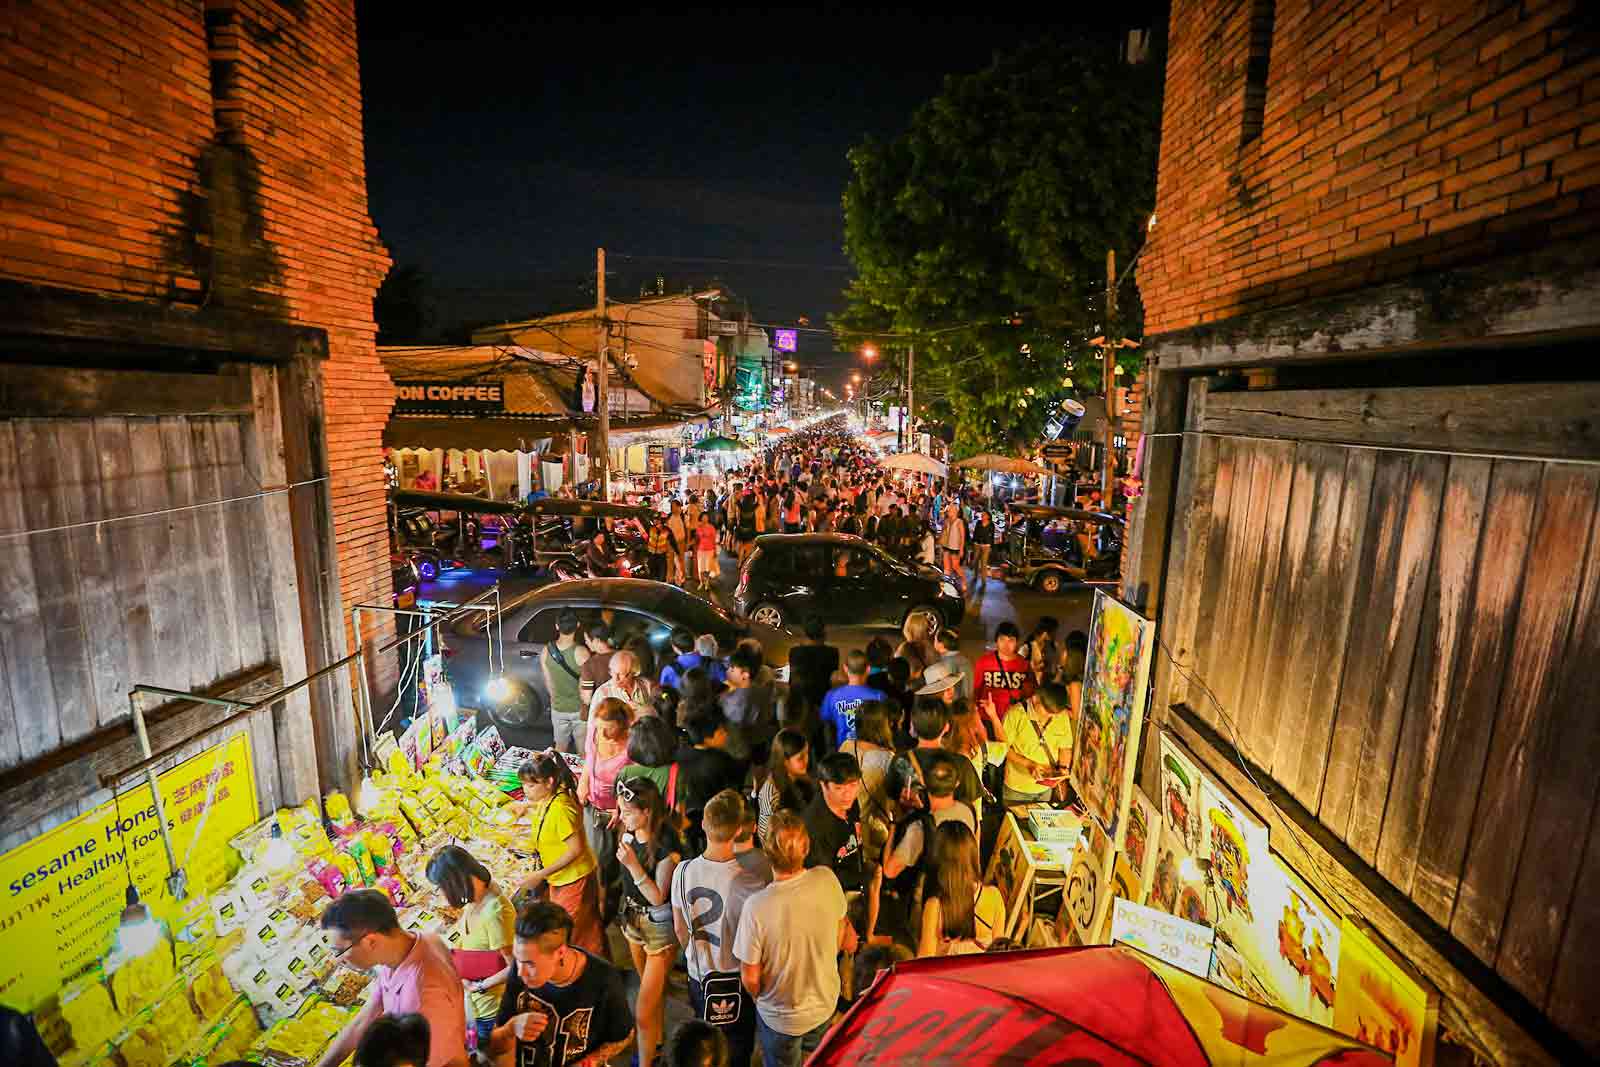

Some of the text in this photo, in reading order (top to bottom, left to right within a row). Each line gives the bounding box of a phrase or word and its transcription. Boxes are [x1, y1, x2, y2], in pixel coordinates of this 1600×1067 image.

[427, 385, 500, 401] COFFEE
[8, 838, 97, 897] sesame
[58, 847, 127, 895] Healthy
[686, 886, 724, 947] 2
